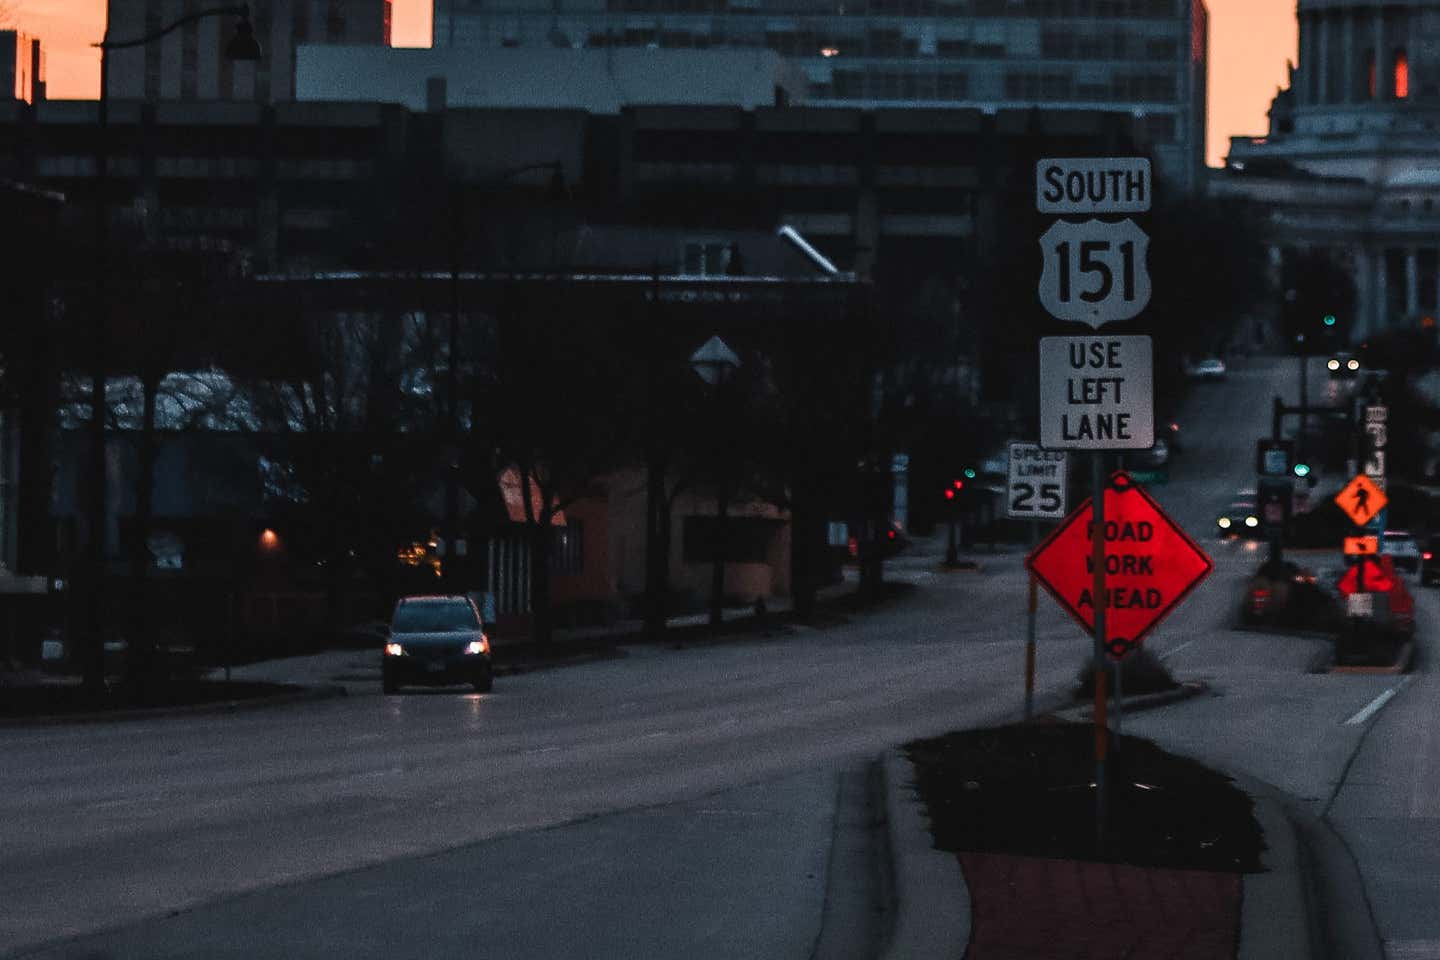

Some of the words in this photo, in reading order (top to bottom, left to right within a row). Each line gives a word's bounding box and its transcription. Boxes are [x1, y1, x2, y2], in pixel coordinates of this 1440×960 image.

[1043, 166, 1145, 202] SOUTH
[1056, 241, 1135, 303] 151
[1070, 342, 1122, 369] USE
[1068, 378, 1125, 405] LEFT
[1063, 414, 1131, 440] LANE
[1013, 449, 1065, 461] SPEED
[1018, 465, 1057, 477] LIMIT
[1012, 483, 1061, 513] 25
